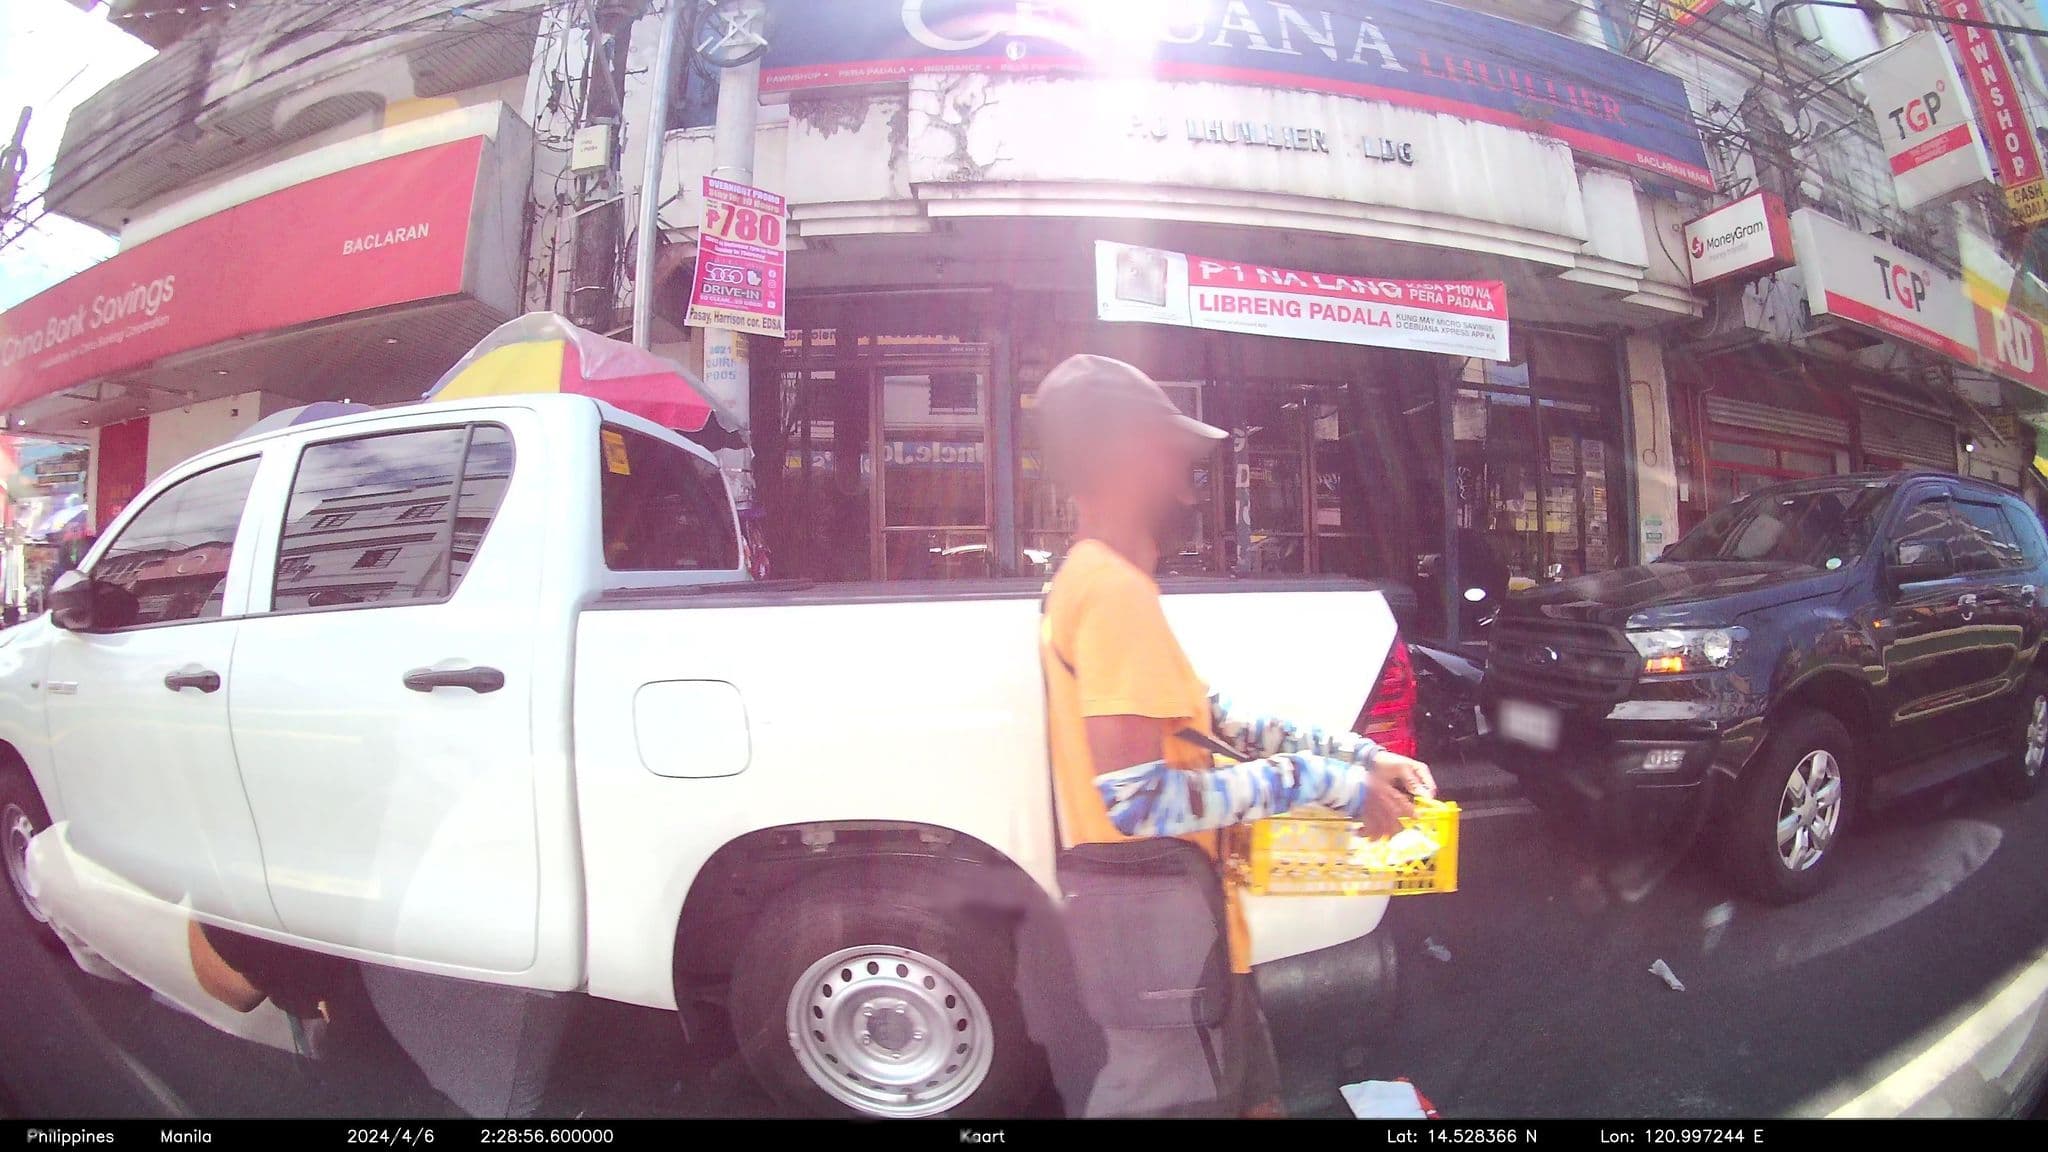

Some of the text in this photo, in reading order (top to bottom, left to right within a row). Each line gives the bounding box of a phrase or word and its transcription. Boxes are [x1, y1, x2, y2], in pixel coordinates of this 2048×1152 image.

[766, 72, 821, 84] PAWNSHOP
[923, 64, 984, 73] INSURANCE
[1956, 3, 2025, 177] PAWNSHOP
[1888, 91, 1942, 140] TGP
[1185, 119, 1329, 154] LHUILLIER
[1636, 152, 1711, 185] BACLARAN MAIN
[2013, 183, 2043, 203] CASH
[343, 223, 429, 255] BACLARAN
[1706, 220, 1764, 251] MoneyGram
[702, 283, 760, 301] DRIVE-IN
[1256, 268, 1309, 288] NA
[1312, 275, 1403, 299] LANG
[1476, 286, 1491, 300] NA
[1873, 255, 1926, 313] TGP
[44, 304, 86, 349] Bank
[90, 274, 176, 330] Savings
[1199, 293, 1393, 329] LIBRENG PADALA
[1409, 288, 1495, 313] PERA PADALA
[713, 310, 746, 327] Harrison
[762, 316, 783, 331] EDSA
[1396, 312, 1418, 324] KUNG
[1419, 315, 1435, 326] MAY
[1436, 317, 1462, 329] MICRO
[1403, 322, 1440, 335] CEBUANA
[1471, 329, 1486, 339] APP
[1486, 332, 1497, 341] KA
[1991, 305, 2034, 374] RD
